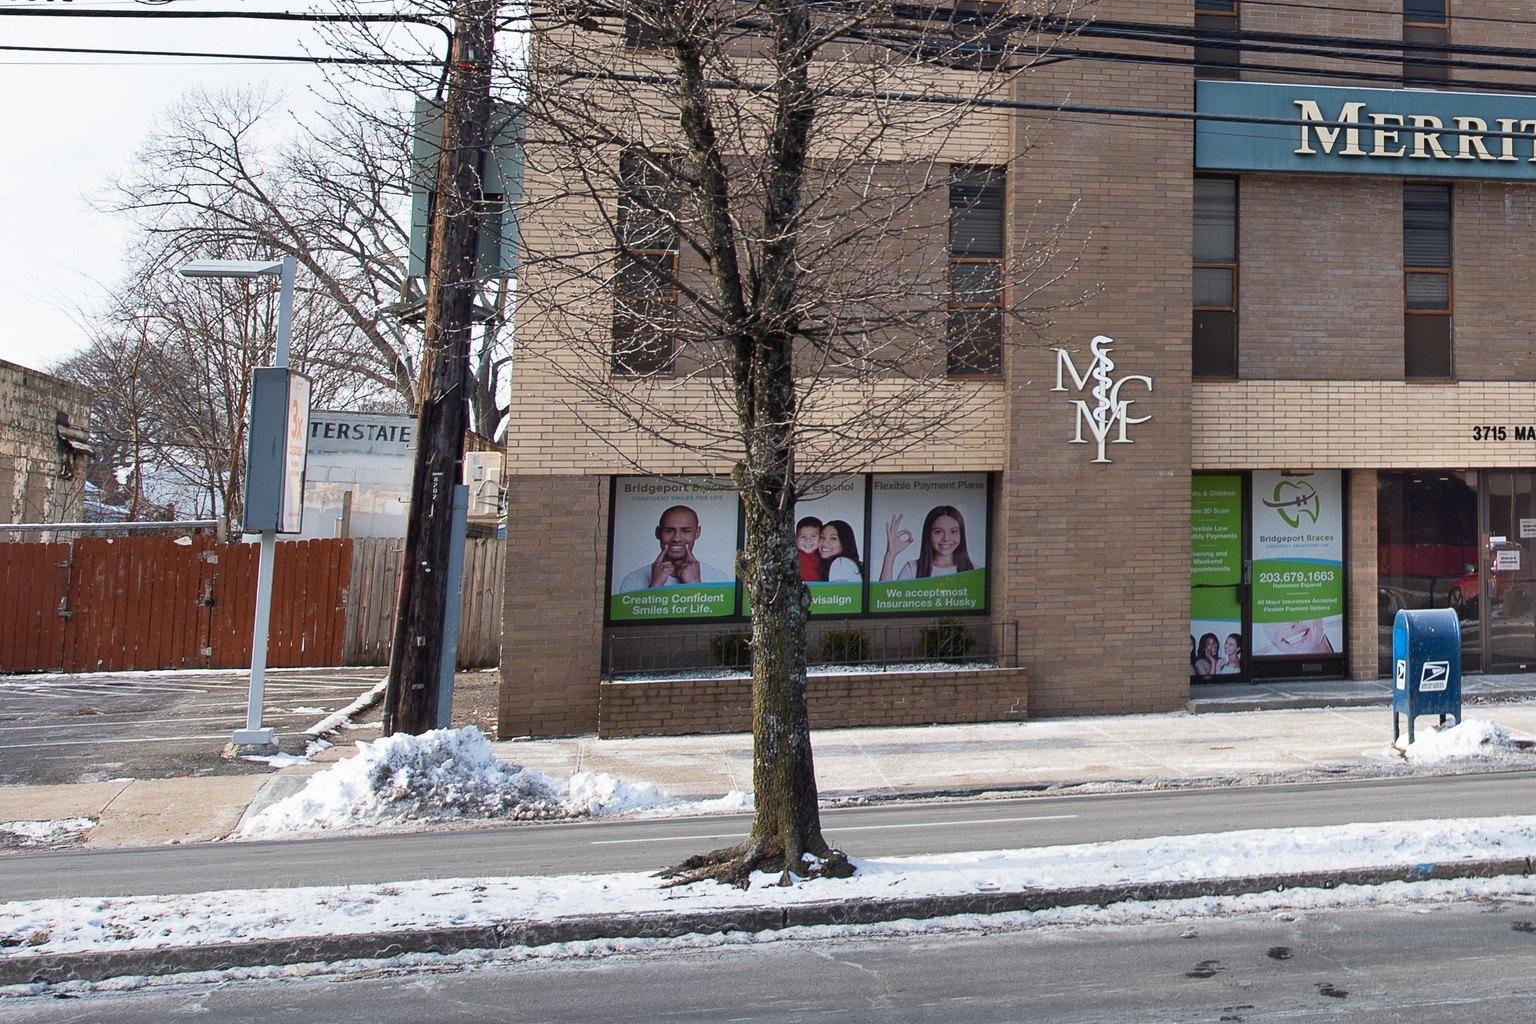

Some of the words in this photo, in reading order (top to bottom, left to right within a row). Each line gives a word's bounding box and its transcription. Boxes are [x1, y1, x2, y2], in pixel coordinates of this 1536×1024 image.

[1473, 426, 1507, 441] 3715
[624, 483, 689, 494] Bridgeport
[874, 481, 912, 491] Flexible
[913, 481, 956, 492] Payment
[958, 481, 984, 490] Plans
[1260, 534, 1305, 543] Bridgeport
[1306, 534, 1334, 542] Braces
[1260, 571, 1334, 582] 203.679.1663
[622, 594, 669, 605] Creating
[671, 593, 725, 603] Confident
[886, 588, 902, 598] We
[905, 589, 940, 599] accept
[942, 588, 968, 597] most
[876, 599, 933, 609] Insurances
[935, 598, 943, 607] &
[946, 597, 977, 608] Husky
[632, 606, 669, 615] Smiles
[672, 605, 687, 614] for
[690, 604, 713, 613] Life.
